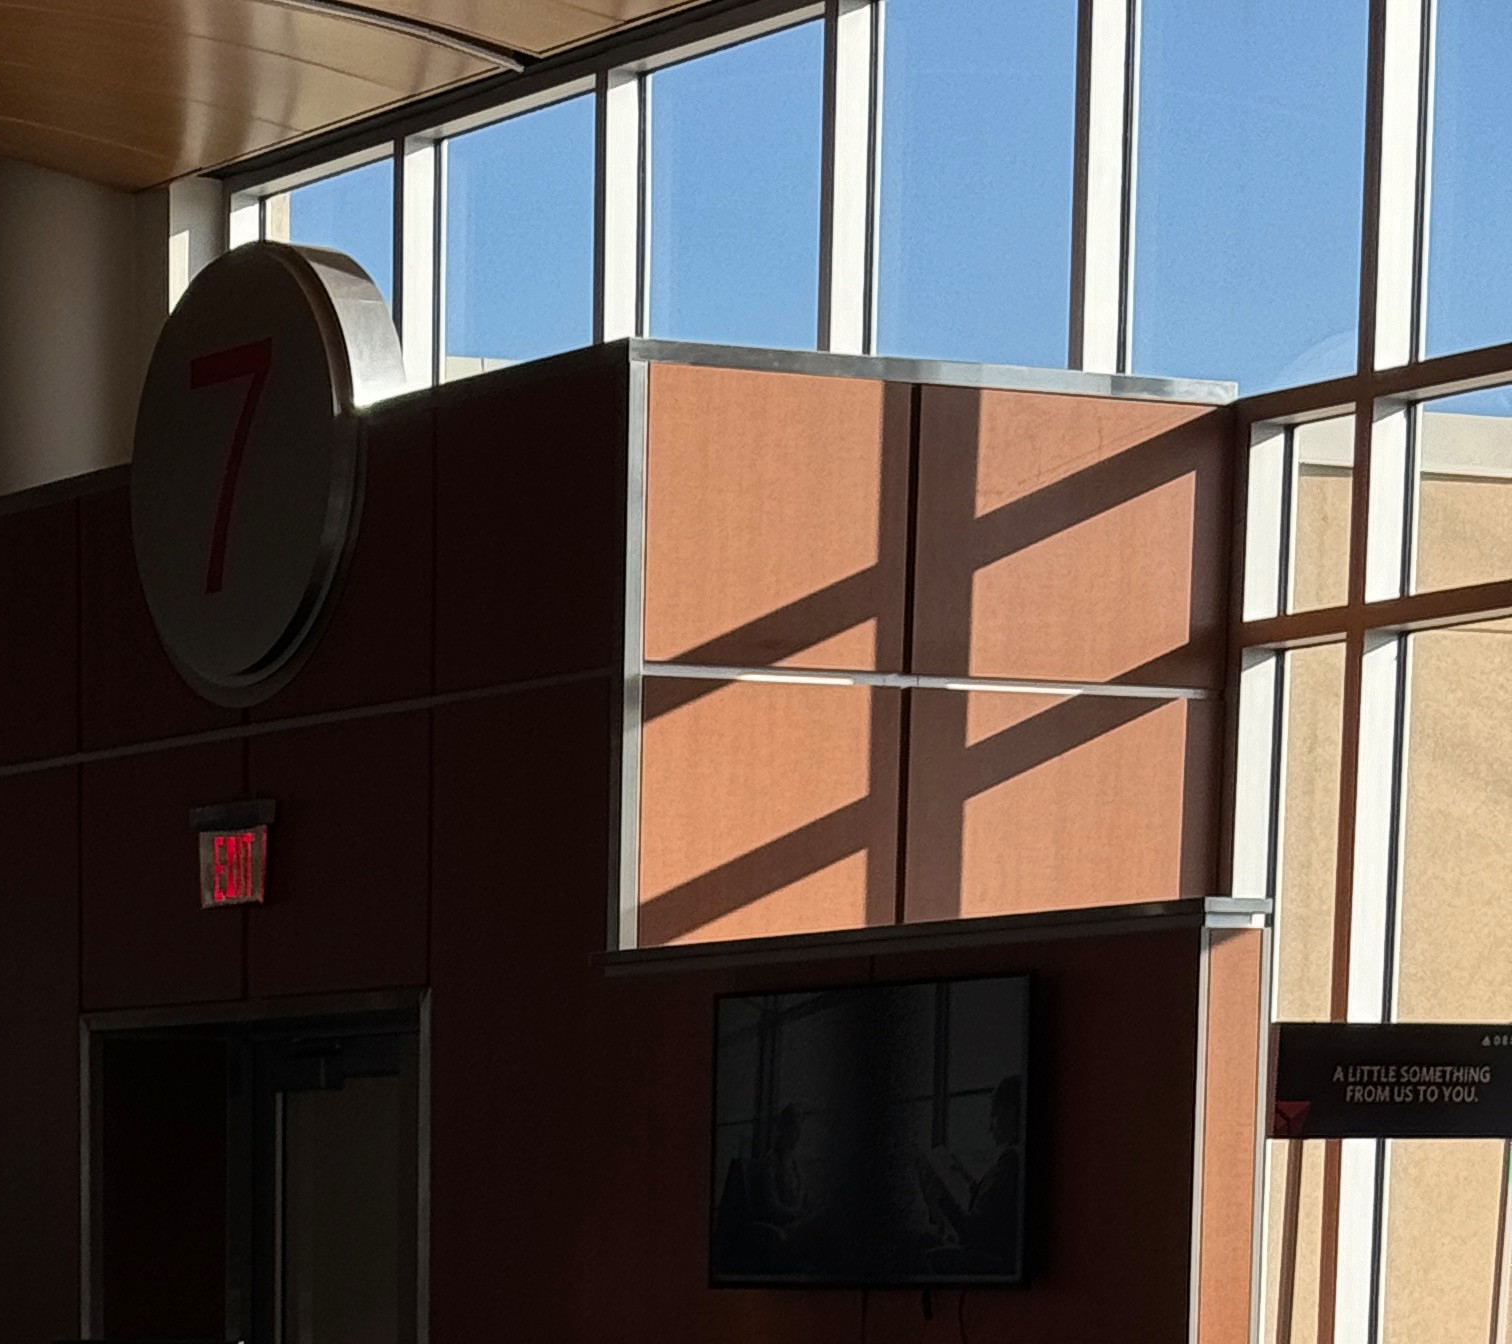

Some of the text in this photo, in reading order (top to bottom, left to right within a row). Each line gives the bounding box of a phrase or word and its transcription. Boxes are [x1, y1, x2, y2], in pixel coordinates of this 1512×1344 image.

[189, 336, 273, 594] 7
[213, 832, 256, 902] EXIT
[1333, 1064, 1491, 1083] A LITTLE SOMETHING
[1345, 1085, 1479, 1103] FROM US TO YOU.
